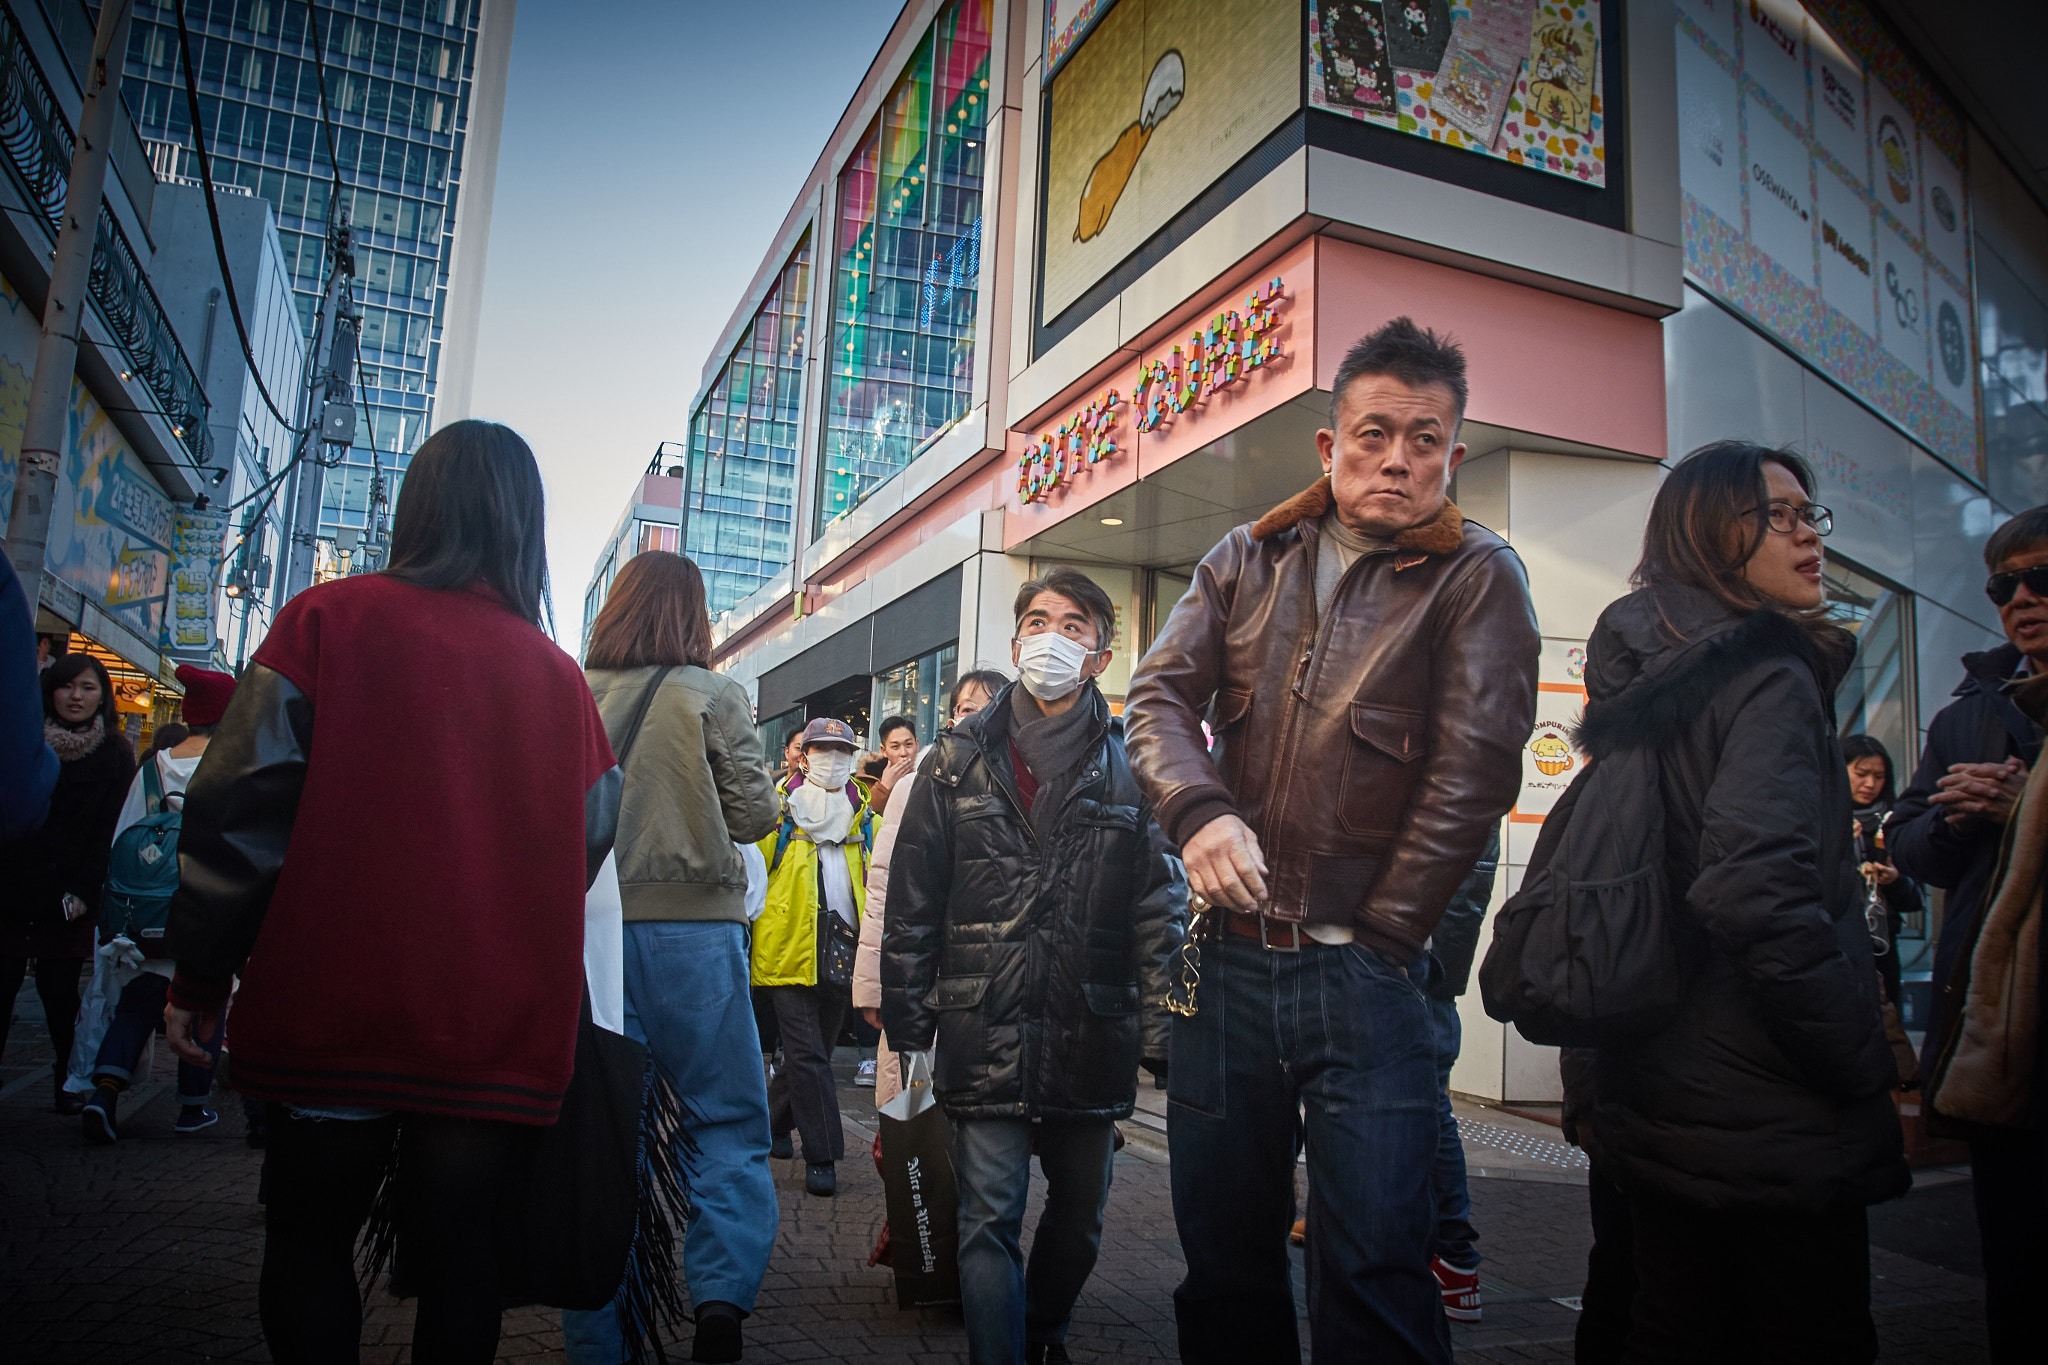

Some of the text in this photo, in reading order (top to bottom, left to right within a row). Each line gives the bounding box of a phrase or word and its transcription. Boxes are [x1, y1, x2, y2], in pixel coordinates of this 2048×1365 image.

[1016, 276, 1285, 506] CUTE CUBE
[907, 1155, 937, 1273] Alice on Wednesday
